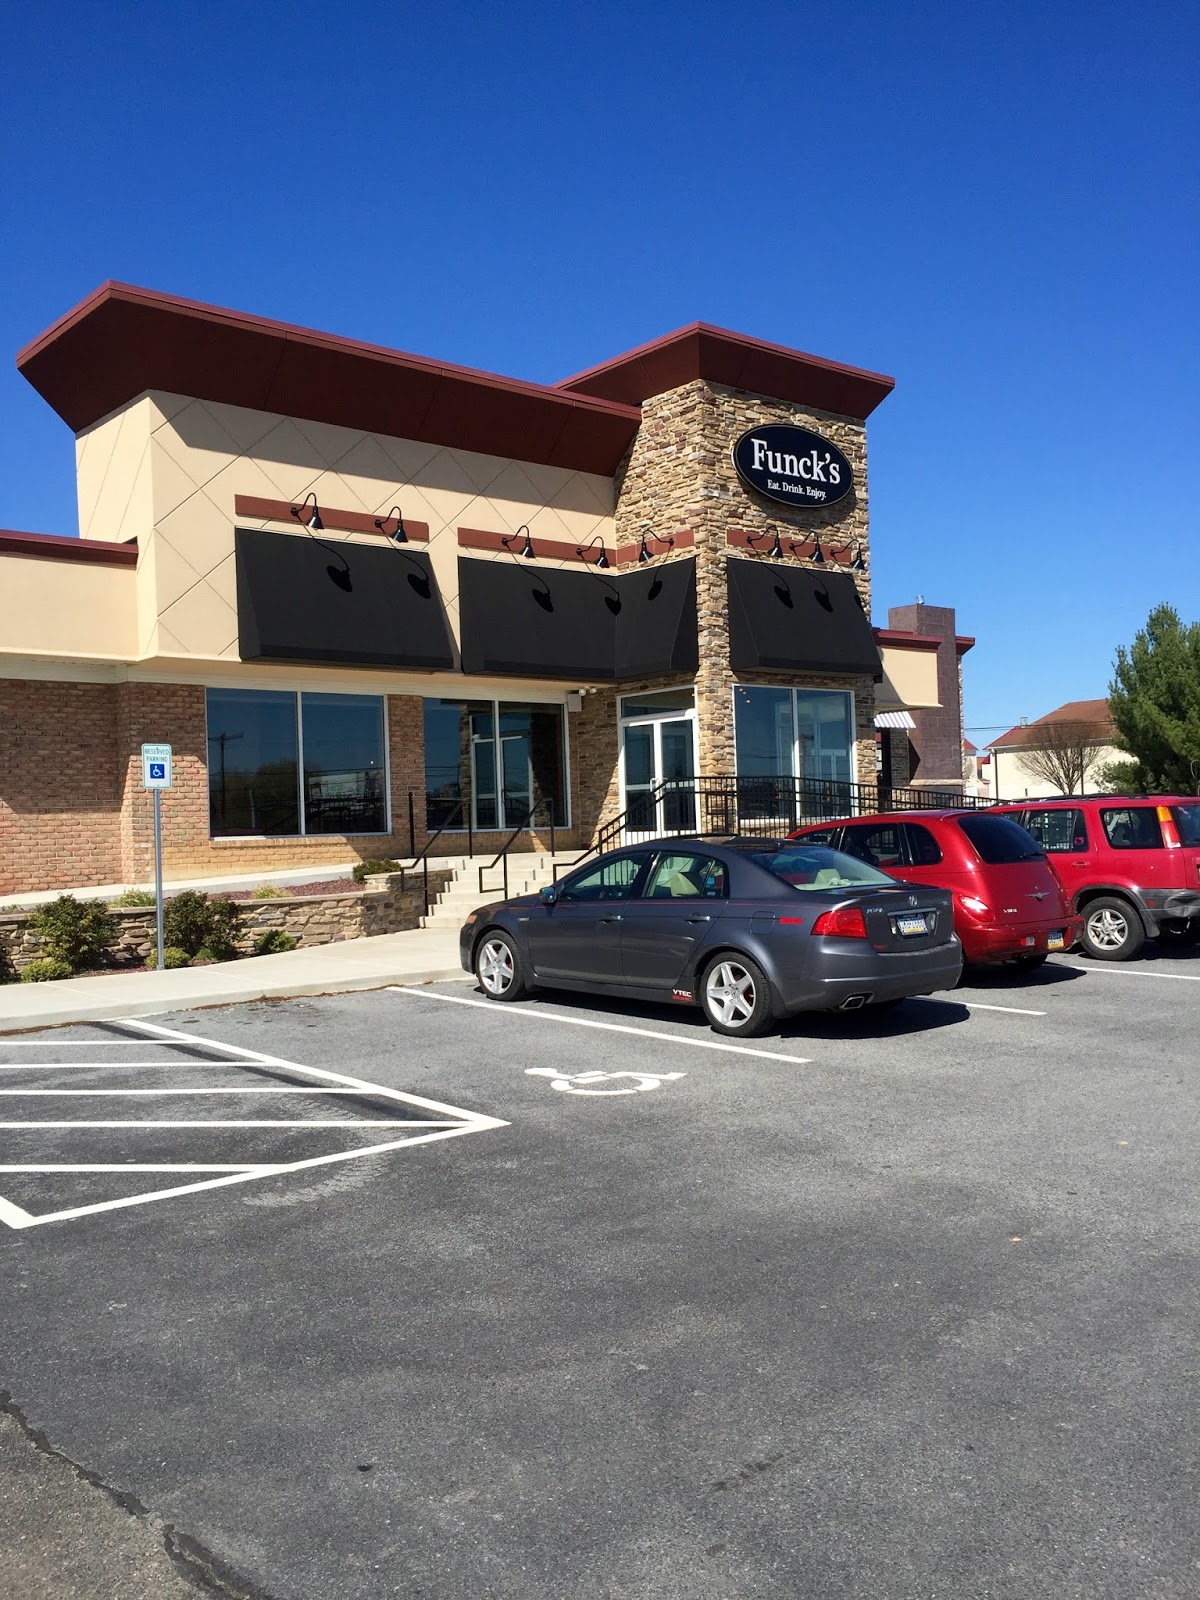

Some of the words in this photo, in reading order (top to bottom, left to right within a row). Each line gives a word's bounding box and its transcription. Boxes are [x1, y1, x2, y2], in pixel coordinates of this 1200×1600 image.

[750, 438, 841, 485] Funck's
[767, 479, 781, 491] Eat.
[782, 482, 805, 495] Drink.
[806, 486, 827, 501] Enjoy.
[672, 988, 692, 998] VTEC
